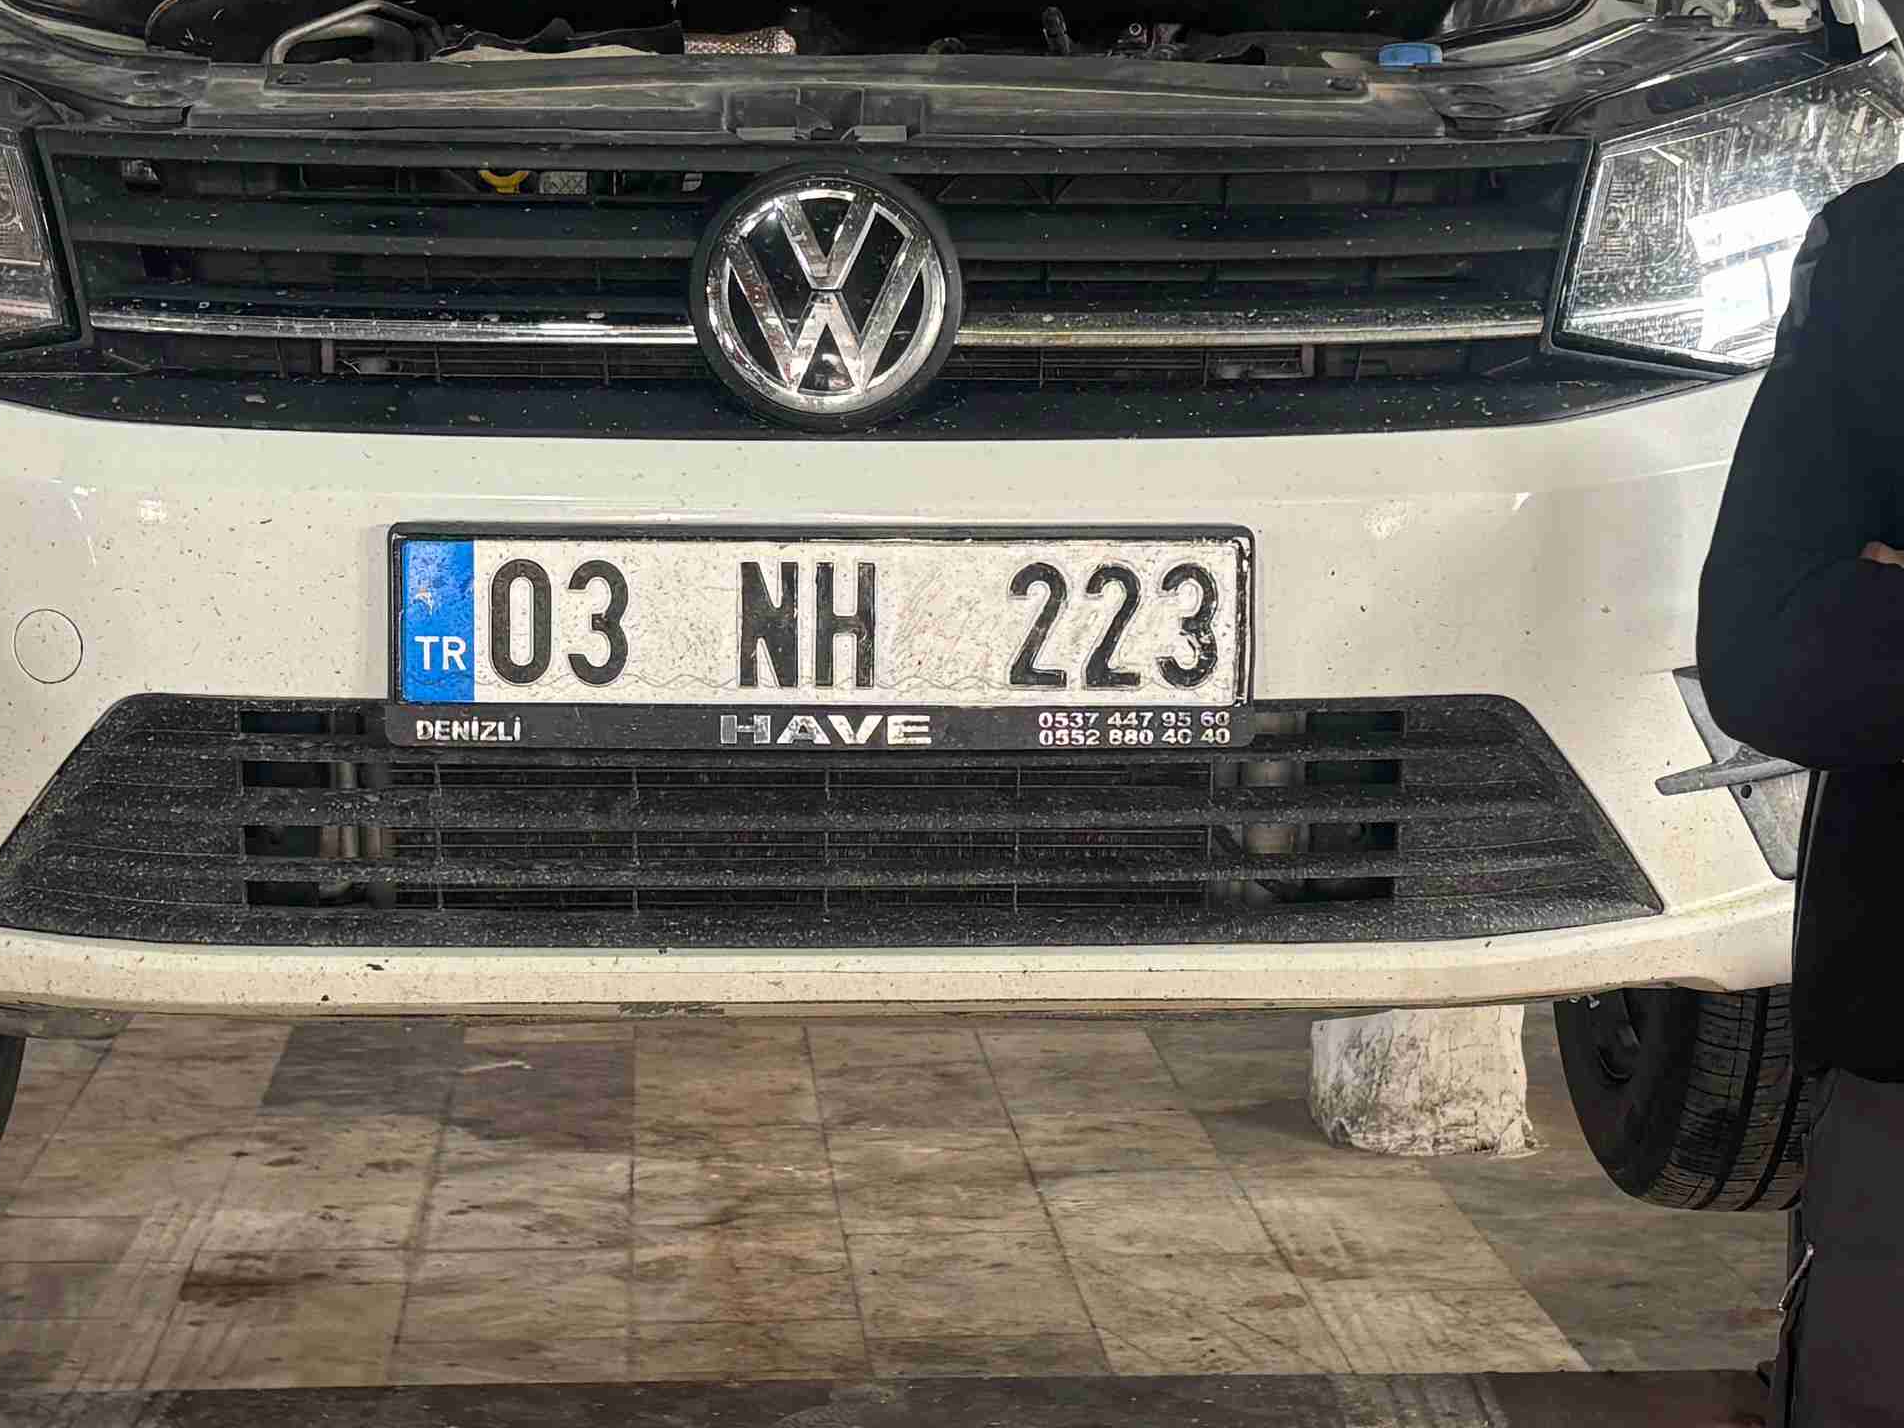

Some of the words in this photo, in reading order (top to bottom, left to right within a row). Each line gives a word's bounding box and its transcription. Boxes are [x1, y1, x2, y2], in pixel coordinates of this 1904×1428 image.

[491, 558, 630, 686] 03
[740, 561, 876, 688] NH
[1008, 561, 1219, 688] 223
[414, 635, 468, 671] TR
[415, 716, 522, 742] DENİZLİ
[720, 714, 932, 745] HAVE
[1038, 711, 1100, 728] 0537
[1107, 711, 1154, 728] 447
[1161, 711, 1192, 727] 95
[1200, 711, 1231, 727] 60
[1038, 728, 1100, 746] 0552
[1108, 728, 1154, 745] 880
[1200, 728, 1231, 745] 40
